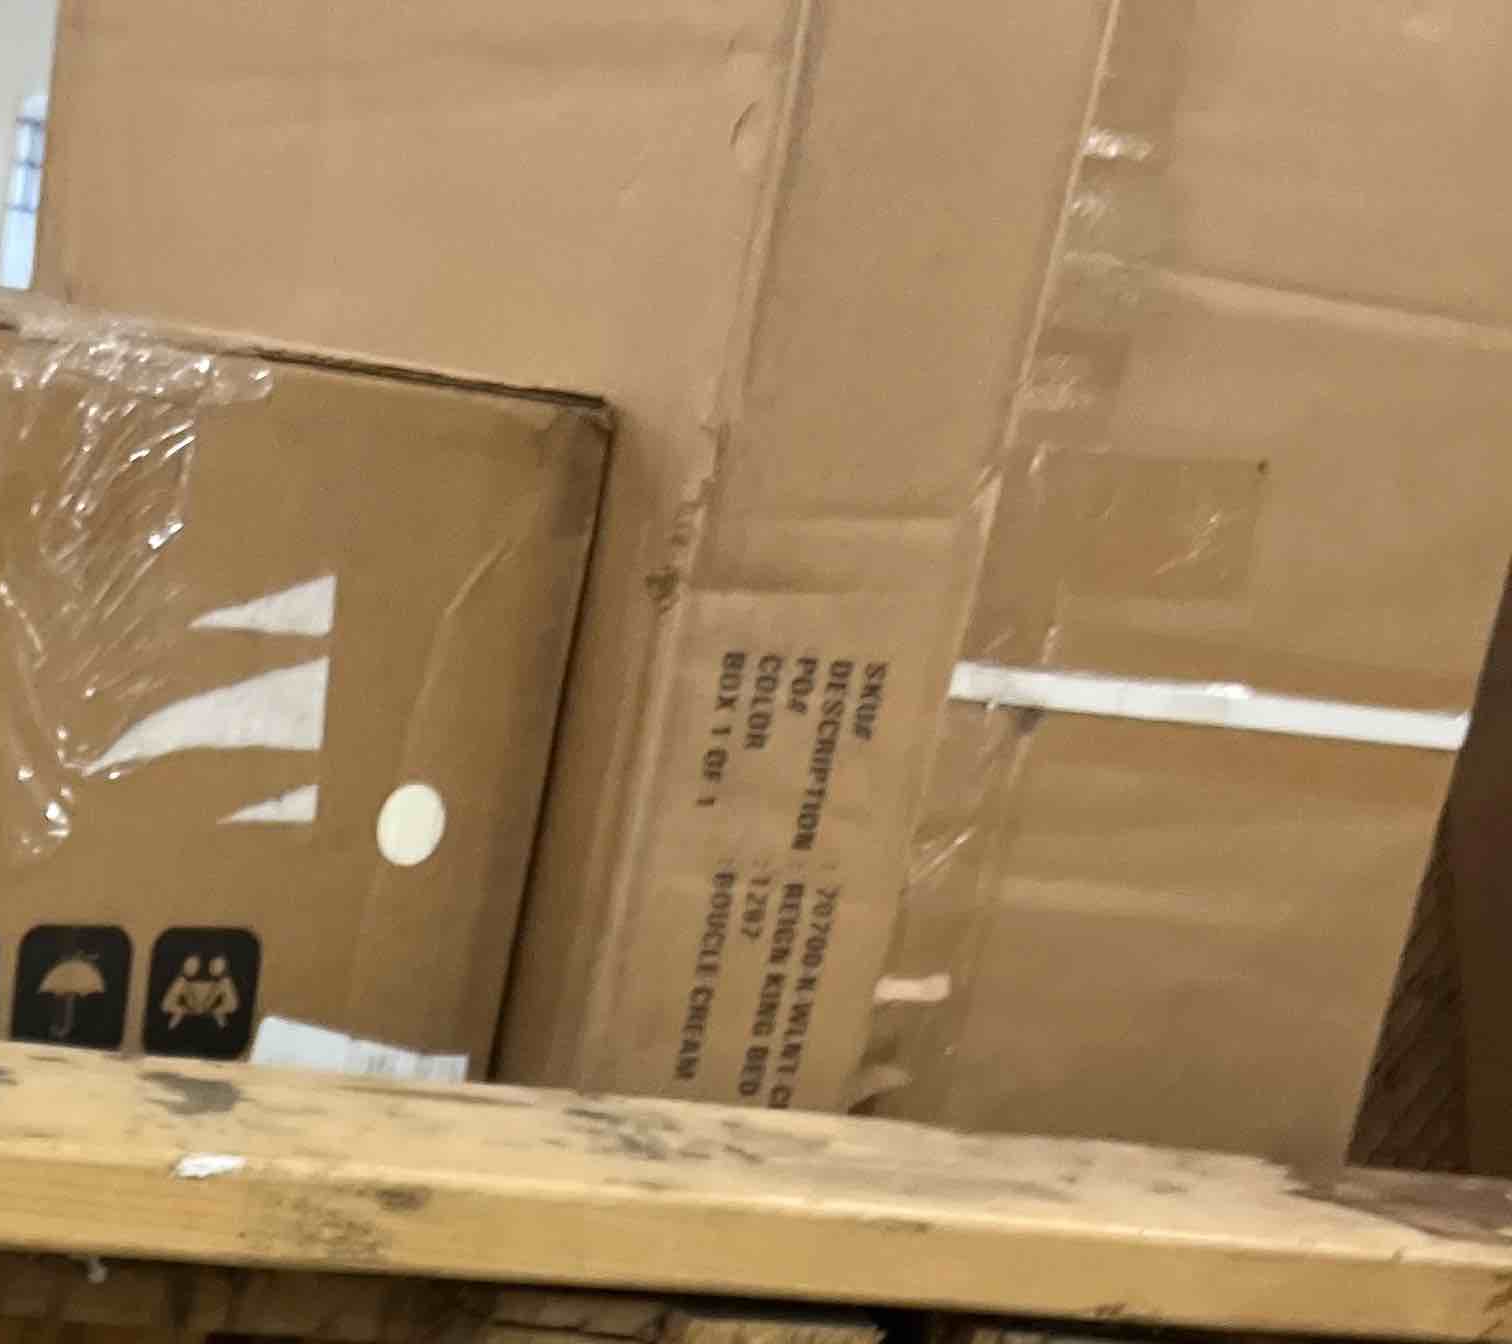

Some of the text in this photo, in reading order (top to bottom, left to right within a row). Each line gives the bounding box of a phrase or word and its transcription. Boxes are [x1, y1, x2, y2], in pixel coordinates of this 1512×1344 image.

[713, 651, 747, 712] BOX
[744, 655, 783, 750] COLOR
[701, 748, 729, 784] OF
[791, 658, 854, 851] DESCRIPTION
[675, 984, 715, 1081] CREAM
[750, 966, 787, 1040] KING
[738, 1045, 770, 1098] BED
